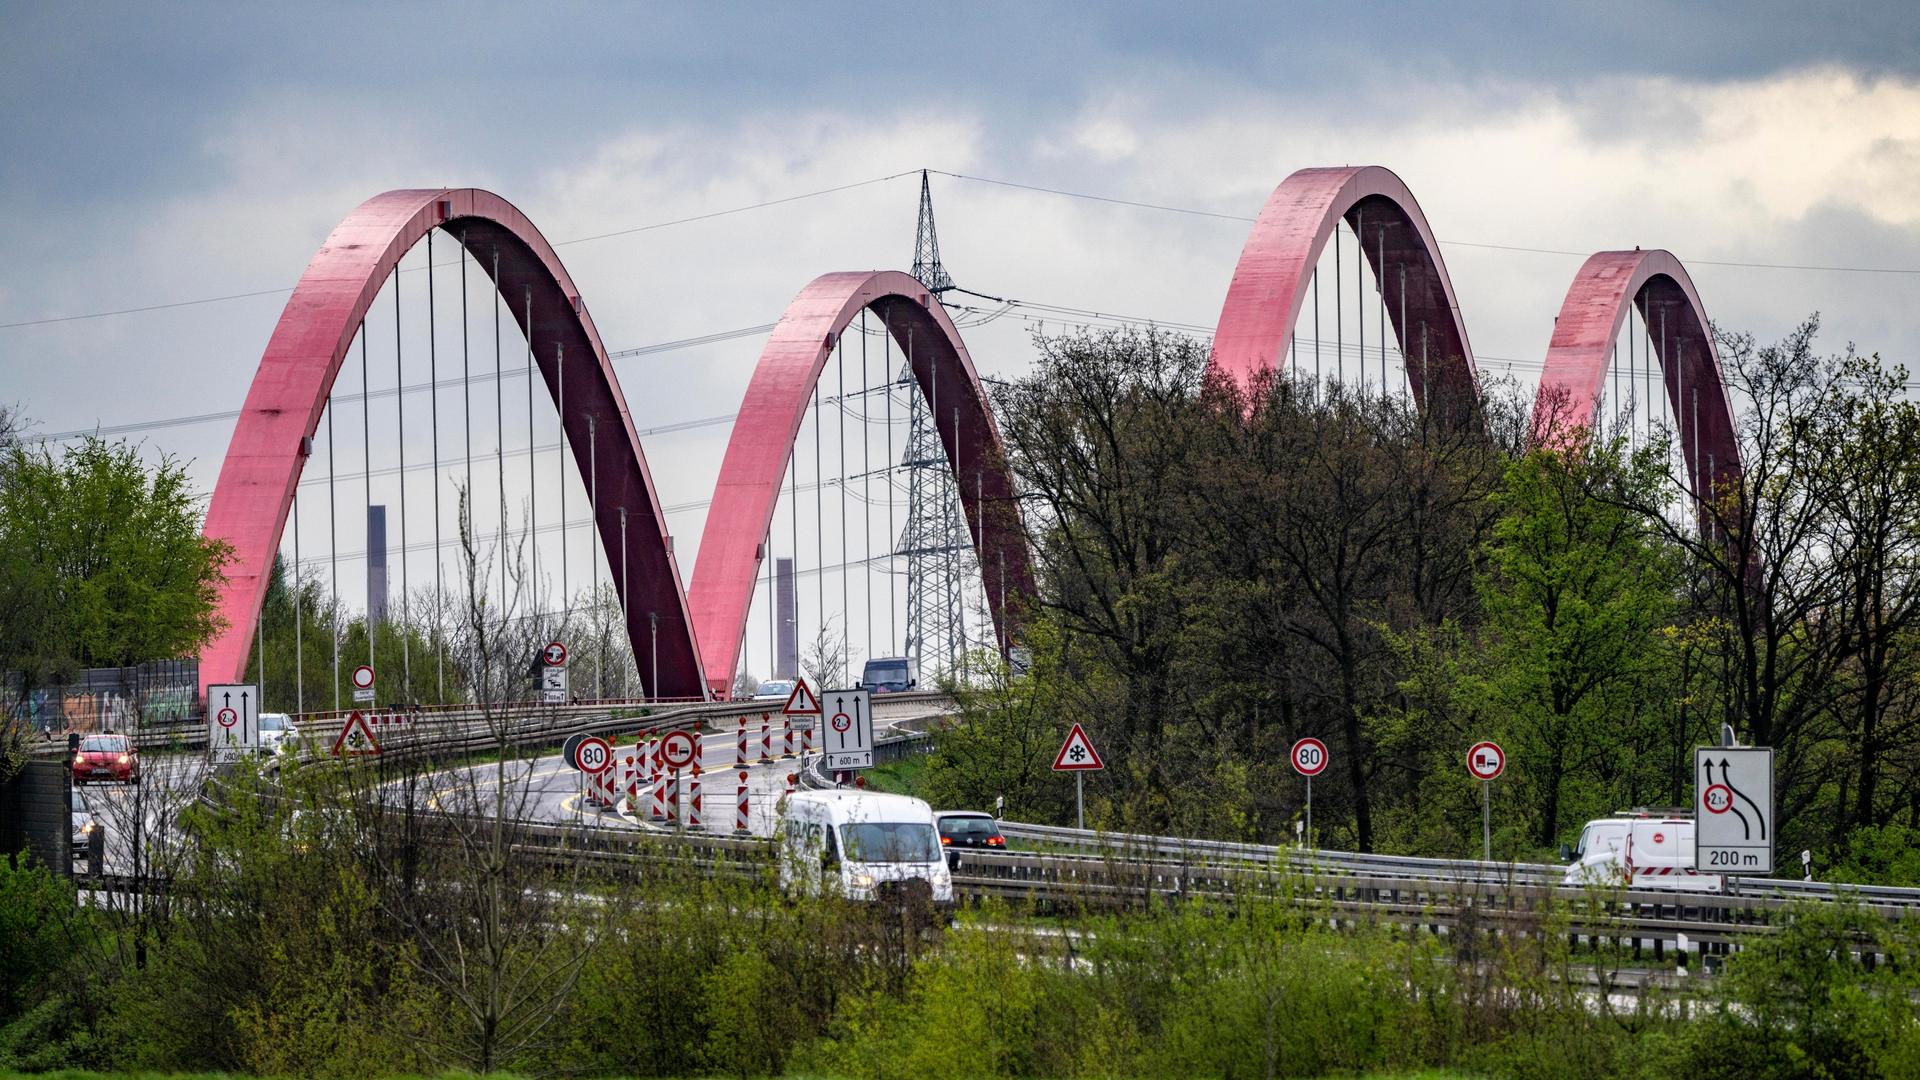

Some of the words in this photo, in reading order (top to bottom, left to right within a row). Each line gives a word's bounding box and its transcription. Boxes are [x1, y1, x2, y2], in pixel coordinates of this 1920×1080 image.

[583, 747, 603, 765] 80
[839, 756, 851, 765] 600
[1299, 748, 1320, 765] 80
[1710, 851, 1739, 865] 200
[1743, 856, 1758, 865] m
